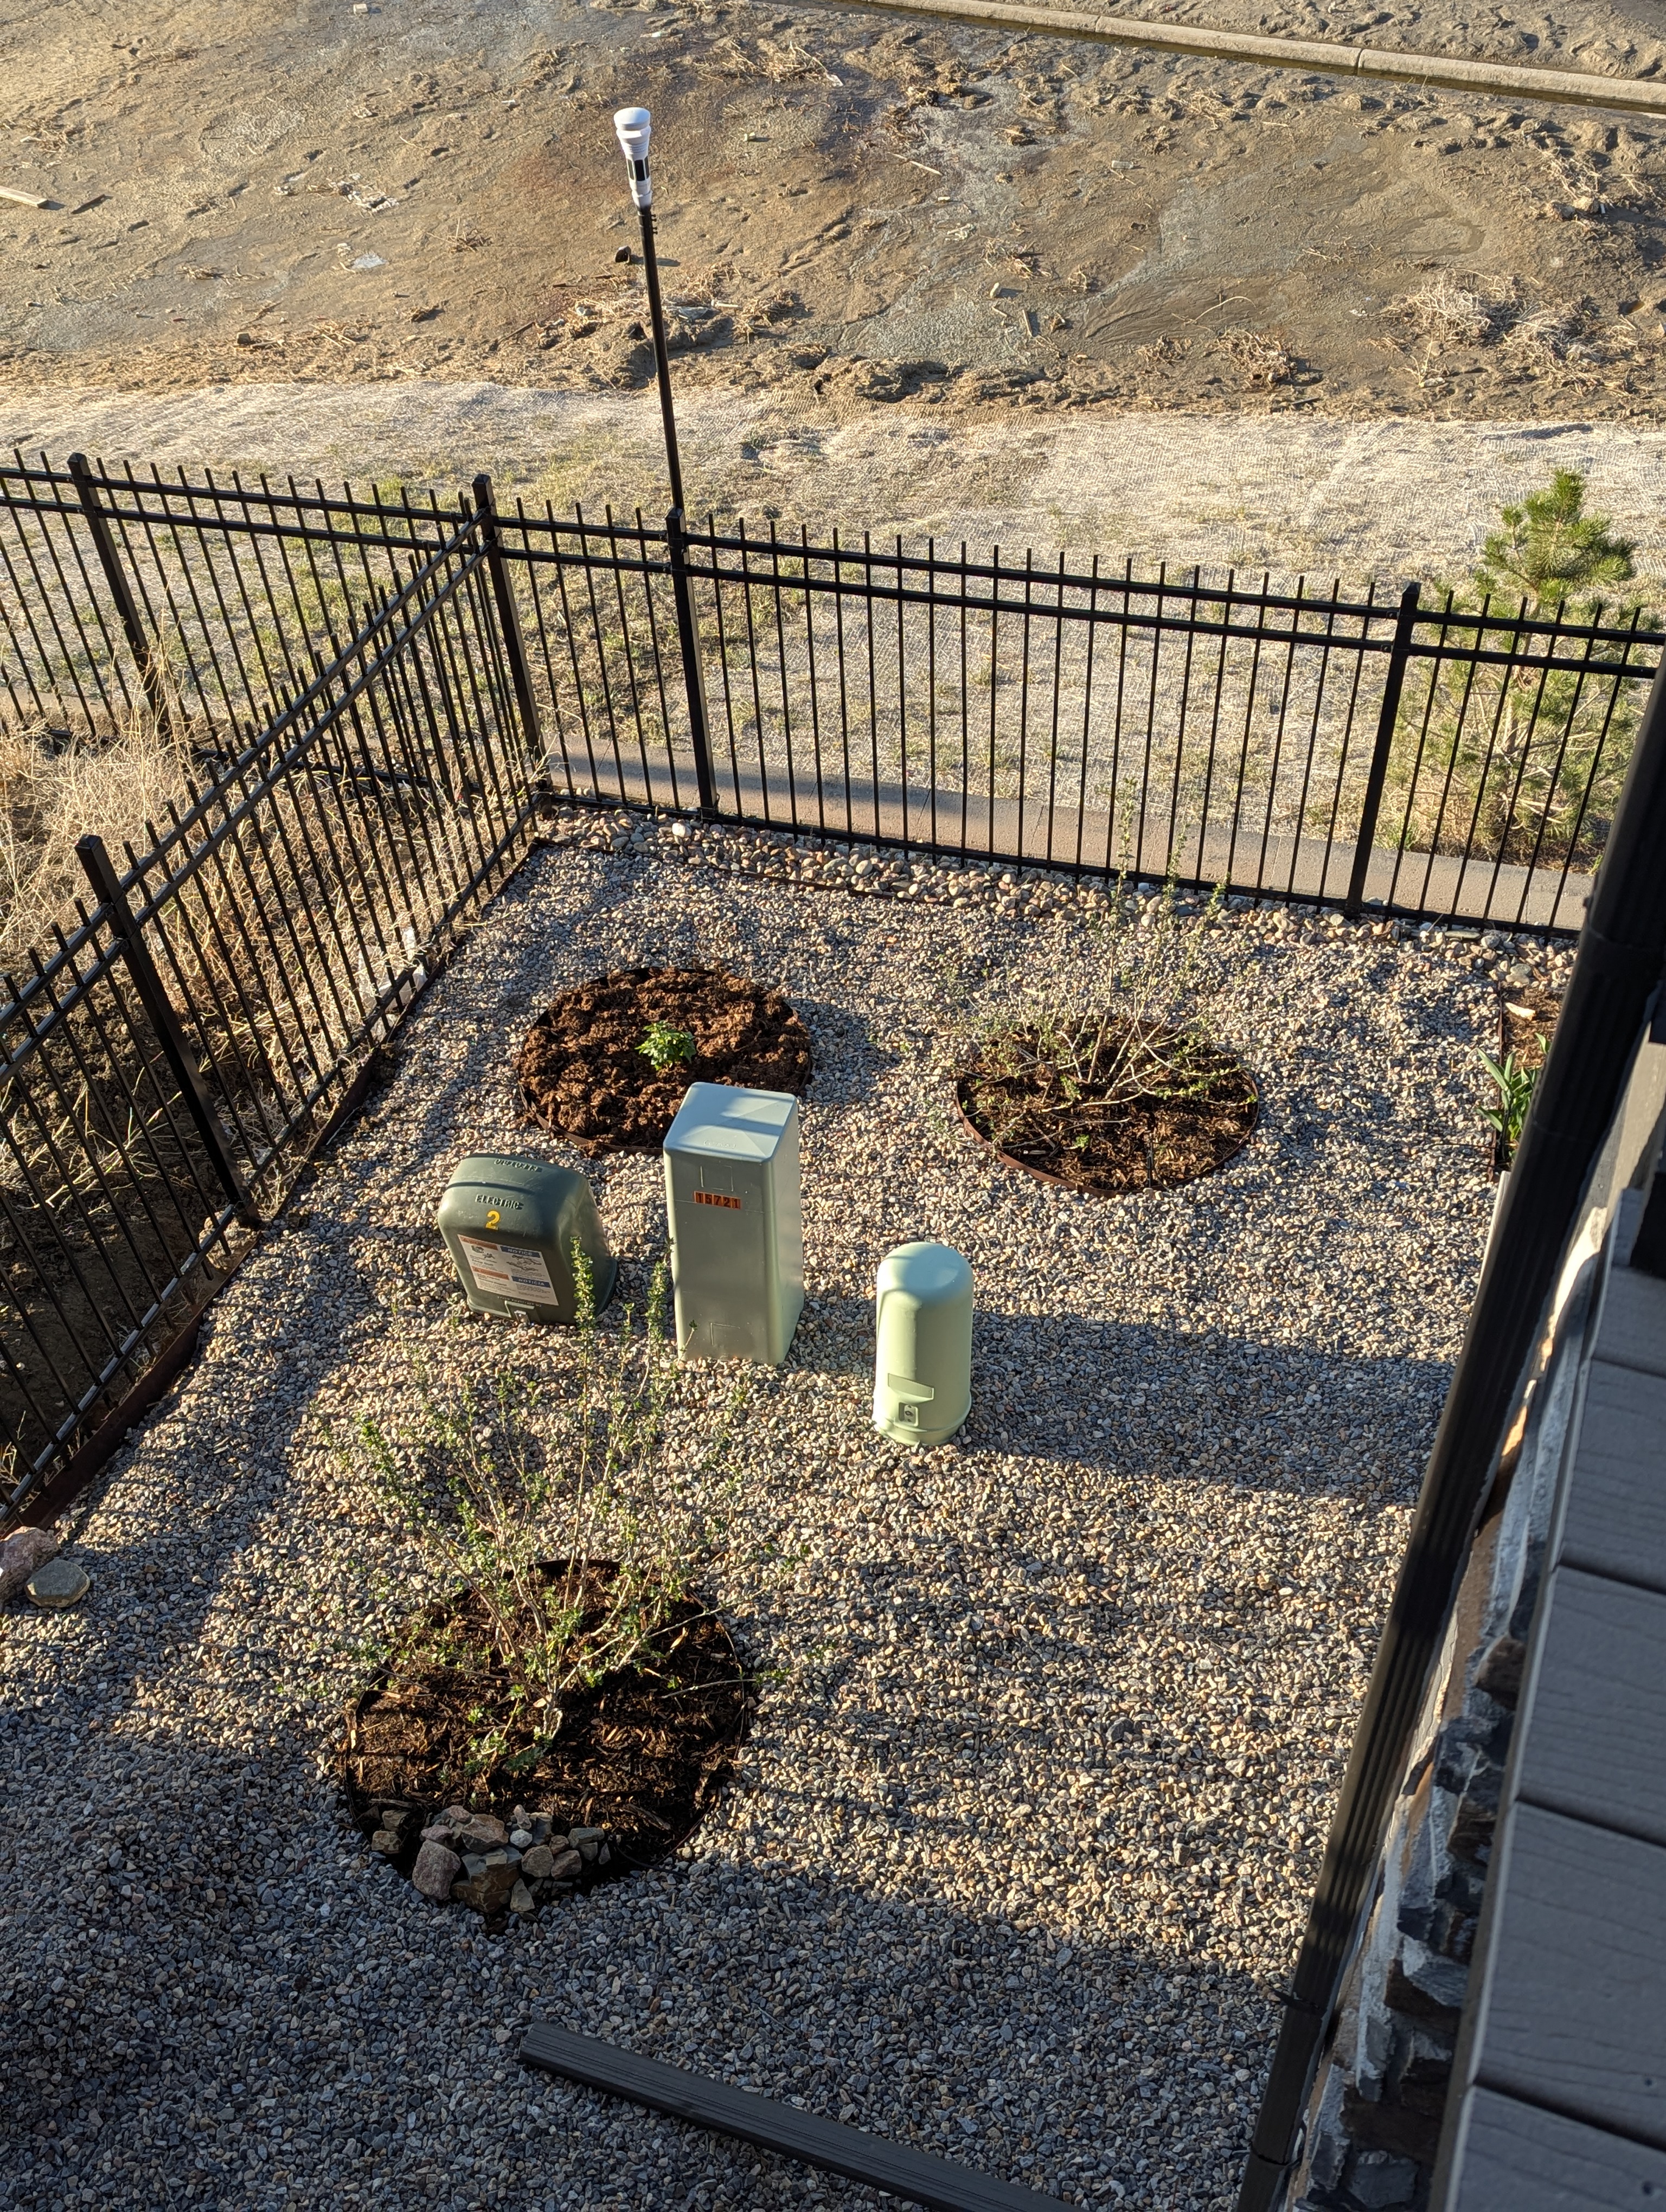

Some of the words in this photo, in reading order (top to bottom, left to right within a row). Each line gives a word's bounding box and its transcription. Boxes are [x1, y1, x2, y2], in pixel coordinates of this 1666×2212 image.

[475, 1194, 521, 1210] ELECTRIC
[696, 1192, 739, 1208] 15721
[485, 1211, 501, 1230] 2
[508, 1248, 533, 1256] NOTICE
